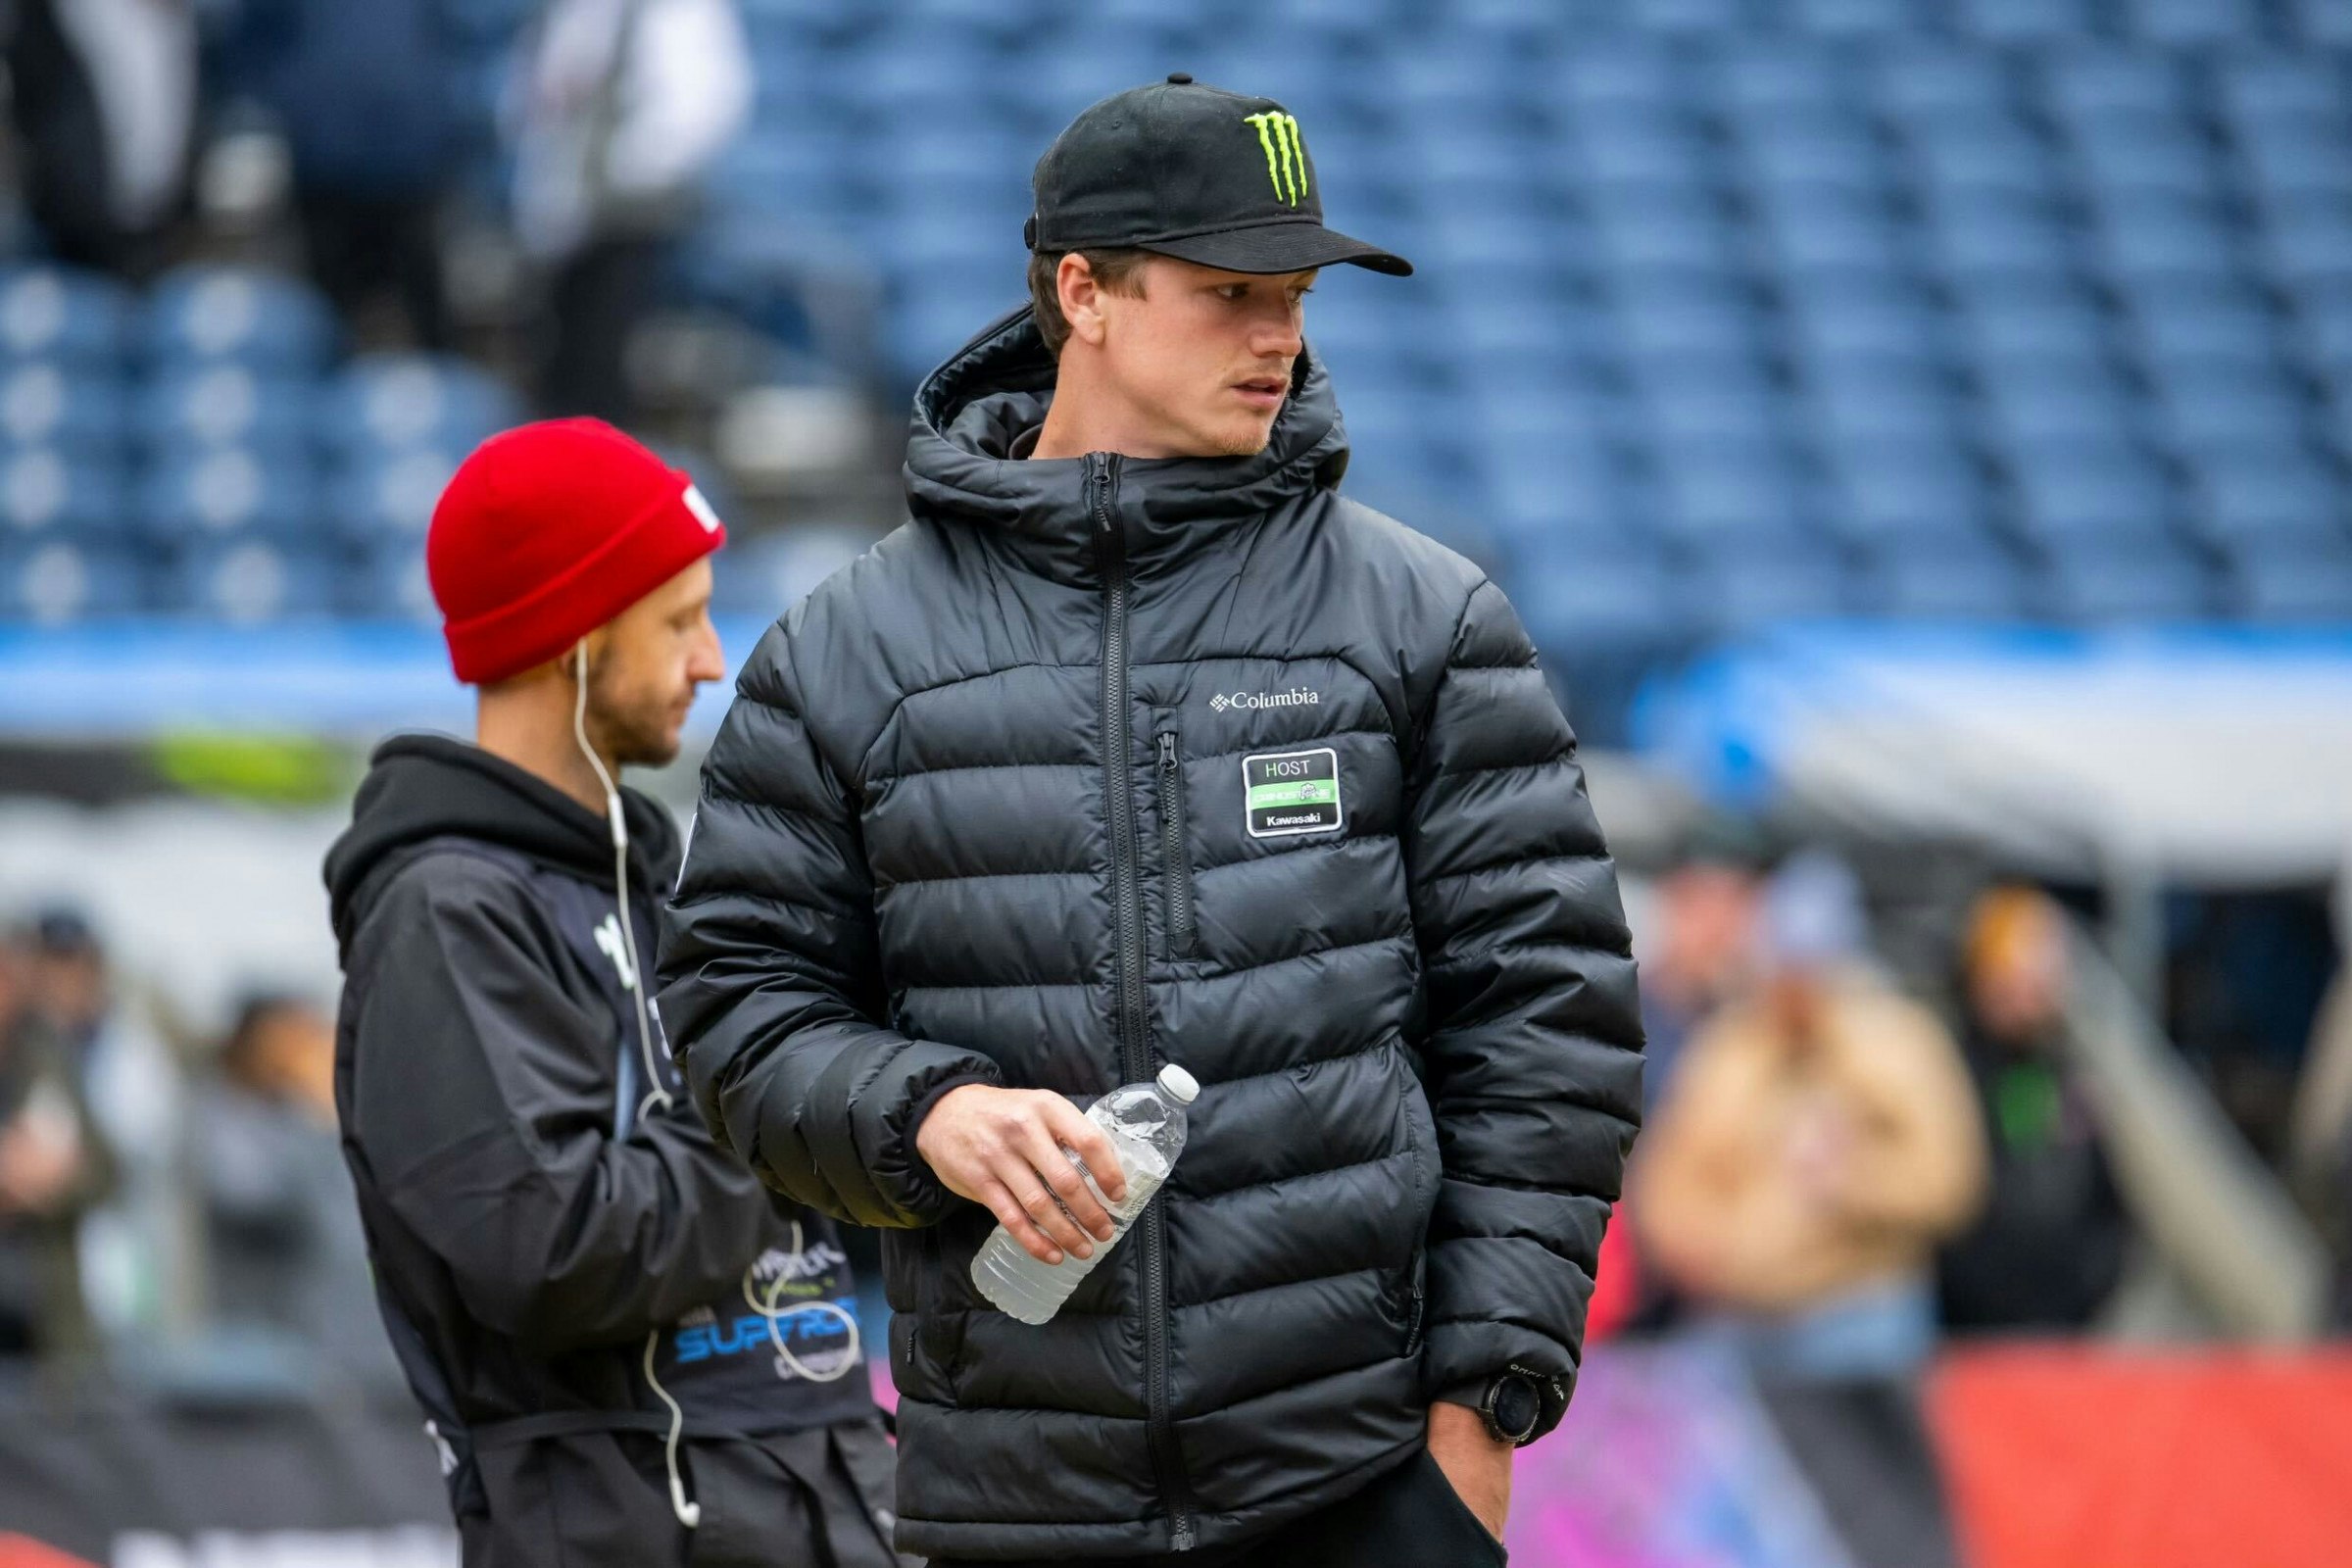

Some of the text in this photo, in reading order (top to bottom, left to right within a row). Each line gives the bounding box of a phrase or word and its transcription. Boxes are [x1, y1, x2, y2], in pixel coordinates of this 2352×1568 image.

[1230, 687, 1319, 710] Columbia
[1265, 760, 1311, 778] HOST
[1266, 812, 1321, 826] Kawasaki
